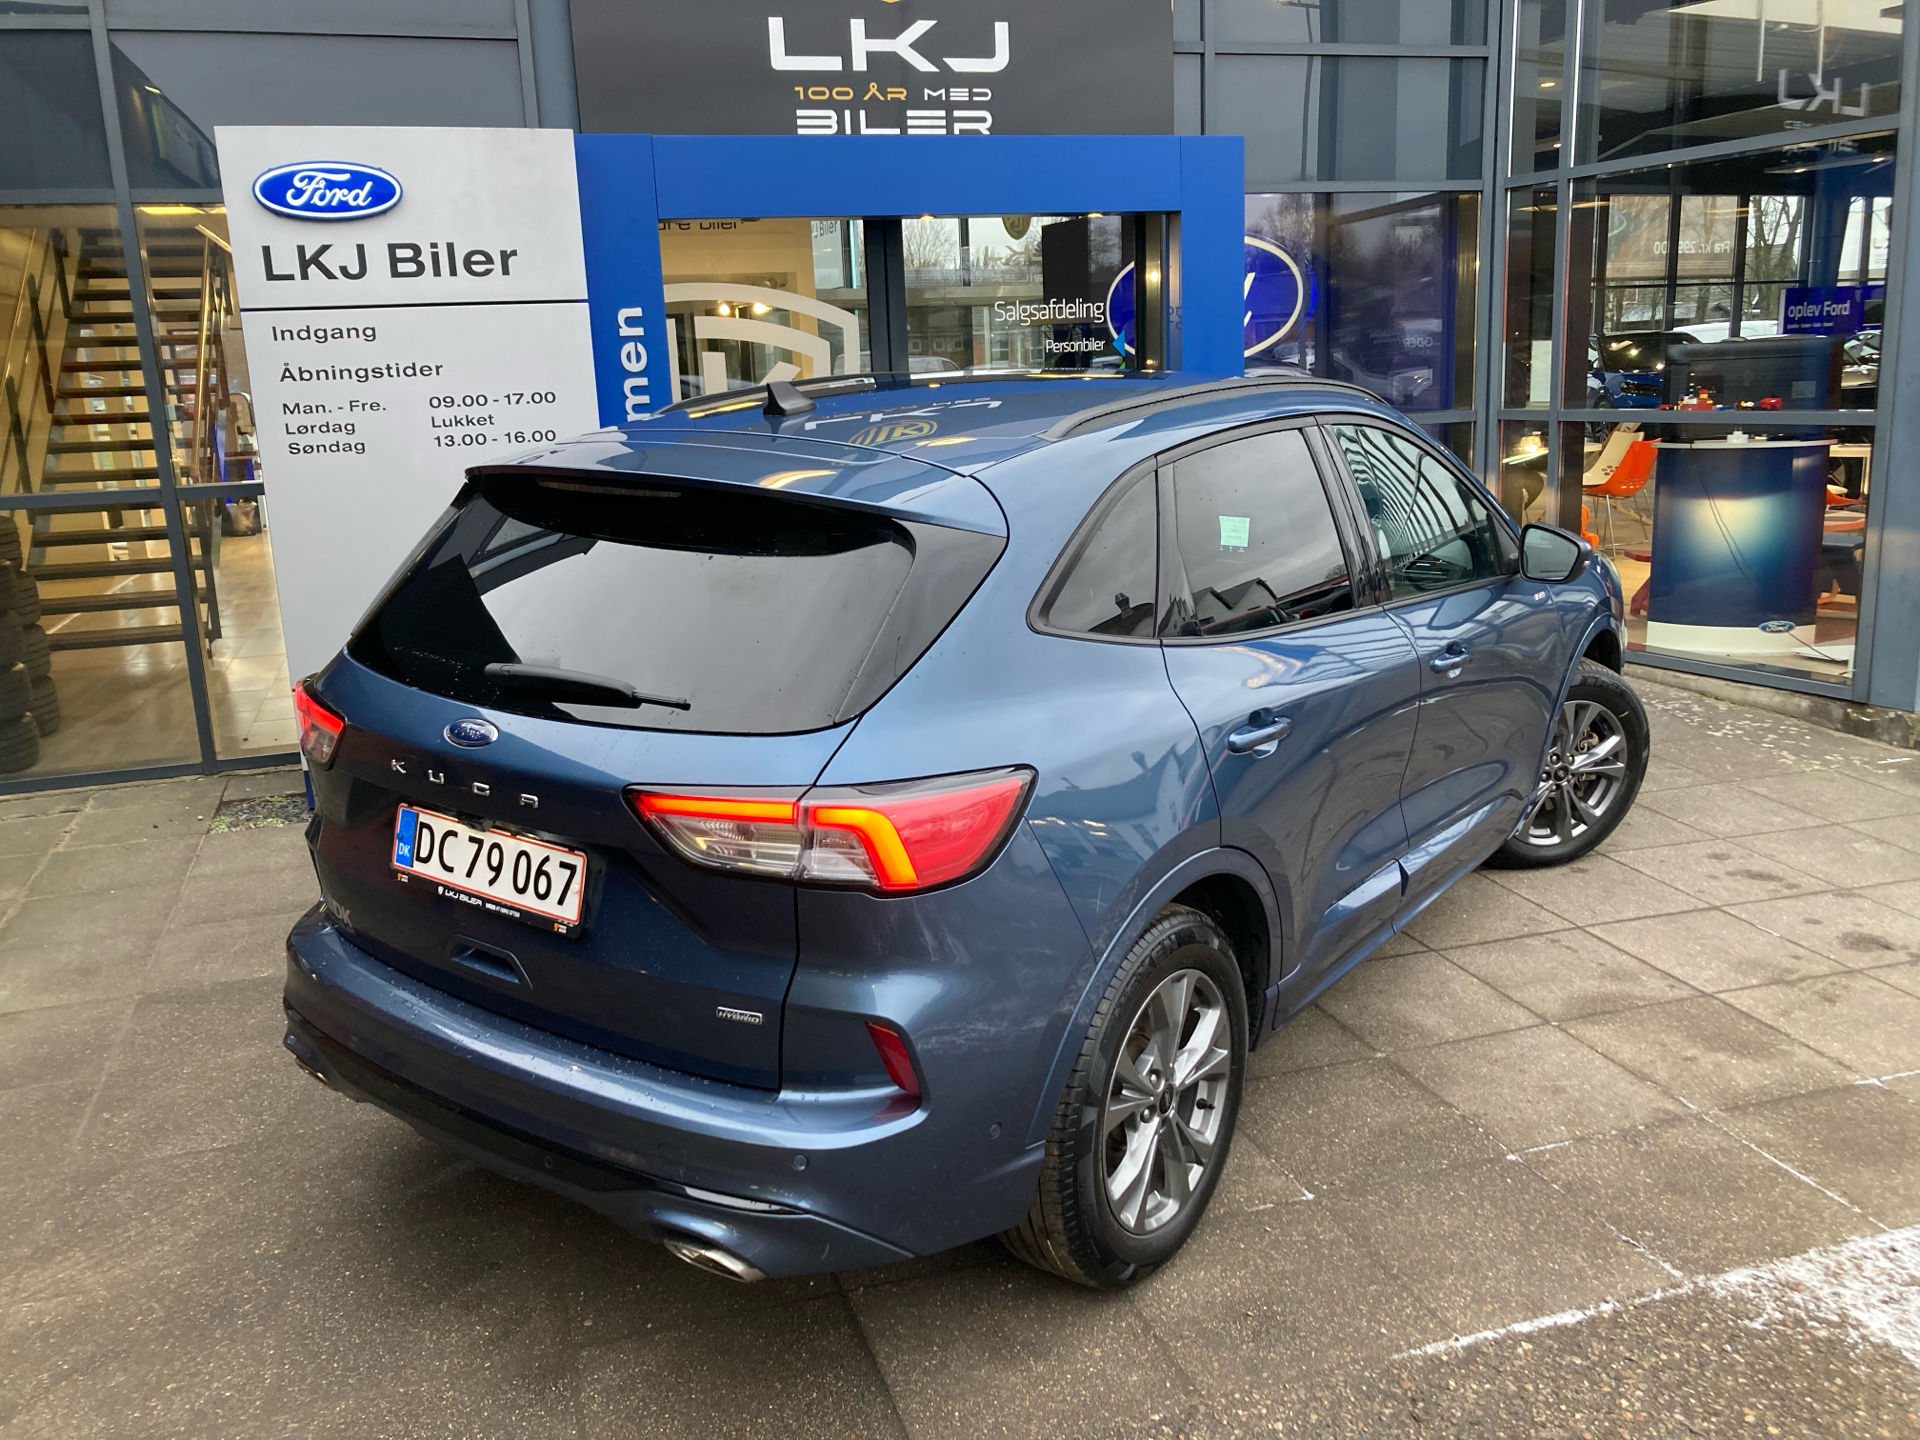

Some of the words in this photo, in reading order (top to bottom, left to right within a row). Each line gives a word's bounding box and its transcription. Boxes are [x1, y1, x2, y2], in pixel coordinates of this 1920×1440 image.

[768, 16, 1010, 72] LKJ
[794, 86, 854, 100] 100
[863, 82, 907, 101] ÅR
[924, 88, 992, 101] MED
[796, 109, 993, 135] BILER
[286, 171, 374, 207] Ford
[261, 243, 368, 282] LKJ
[387, 241, 519, 279] Biler
[994, 298, 1105, 326] Salgsafdeling
[1787, 301, 1822, 321] oplev
[1823, 299, 1851, 316] Ford
[271, 325, 377, 344] Indgang
[1045, 337, 1106, 353] Personbiler
[279, 362, 444, 383] Åbningstider
[617, 307, 651, 423] men
[282, 402, 333, 415] Man.
[349, 399, 387, 412] Fre.
[428, 394, 489, 409] 09.00
[503, 391, 557, 405] 17.00
[285, 421, 356, 435] Lørdag
[431, 413, 495, 428] Lukket
[288, 441, 366, 455] Søndag
[433, 432, 488, 448] 13.00
[504, 429, 557, 444] 16.00
[391, 758, 539, 809] KUGA
[397, 842, 411, 857] DK
[414, 820, 459, 874] DC
[464, 835, 505, 887] 79
[512, 849, 578, 907] 067
[718, 1009, 760, 1023] HYBRID
